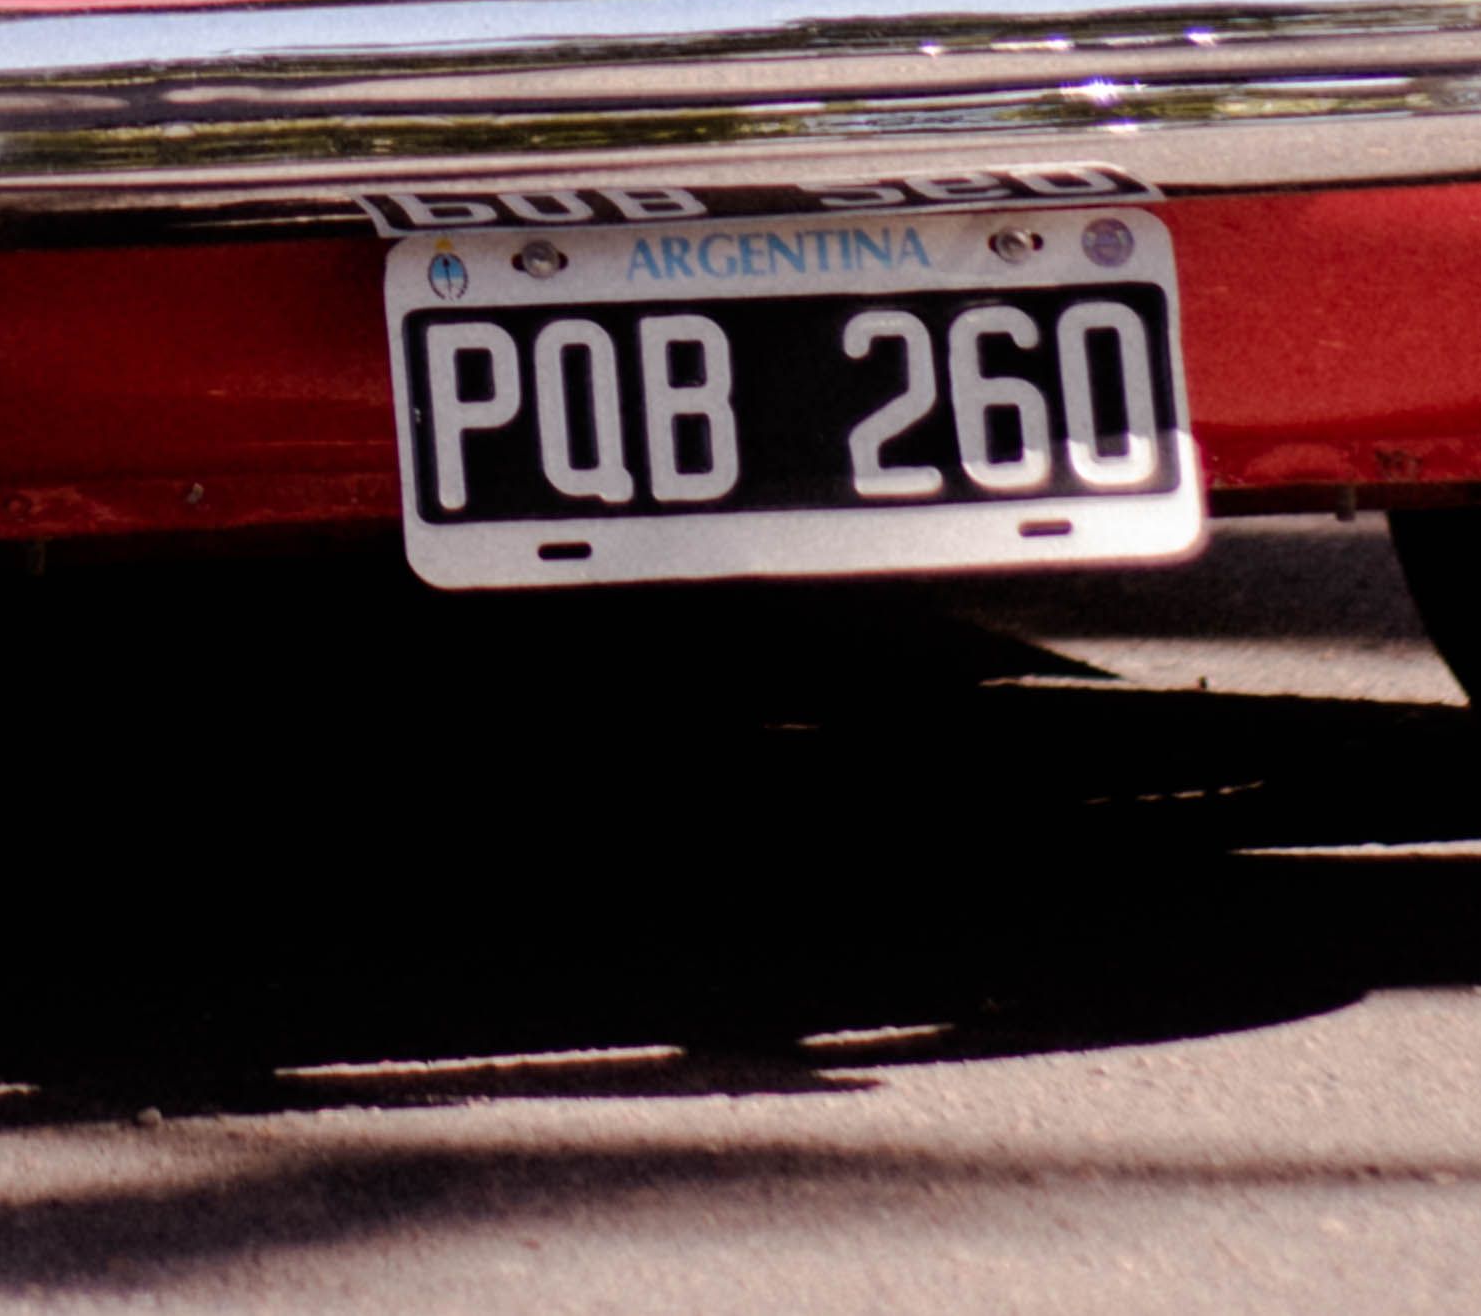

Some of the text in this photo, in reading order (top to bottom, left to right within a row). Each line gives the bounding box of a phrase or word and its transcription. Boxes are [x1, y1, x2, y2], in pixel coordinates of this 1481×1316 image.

[626, 226, 932, 283] ARGENTINA
[426, 300, 1158, 511] PQB 260
